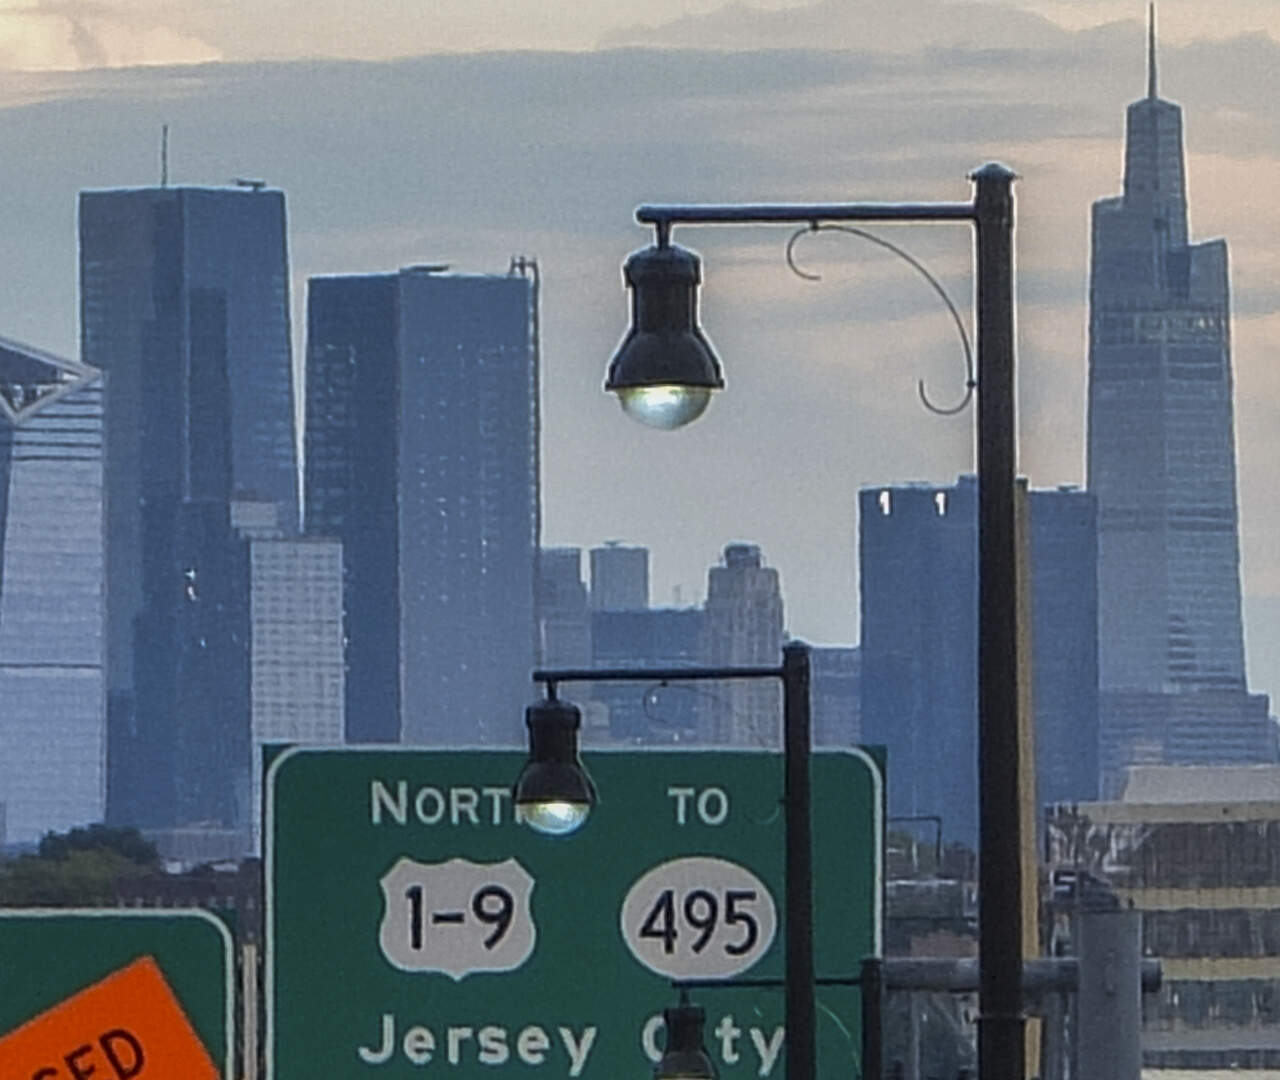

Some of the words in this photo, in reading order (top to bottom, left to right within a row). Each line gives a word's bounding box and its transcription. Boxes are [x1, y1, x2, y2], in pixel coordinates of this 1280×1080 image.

[668, 788, 728, 826] TO
[405, 885, 515, 950] 1-9
[639, 890, 758, 956] 495
[358, 1014, 597, 1077] Jersey
[642, 1014, 786, 1077] Cty
